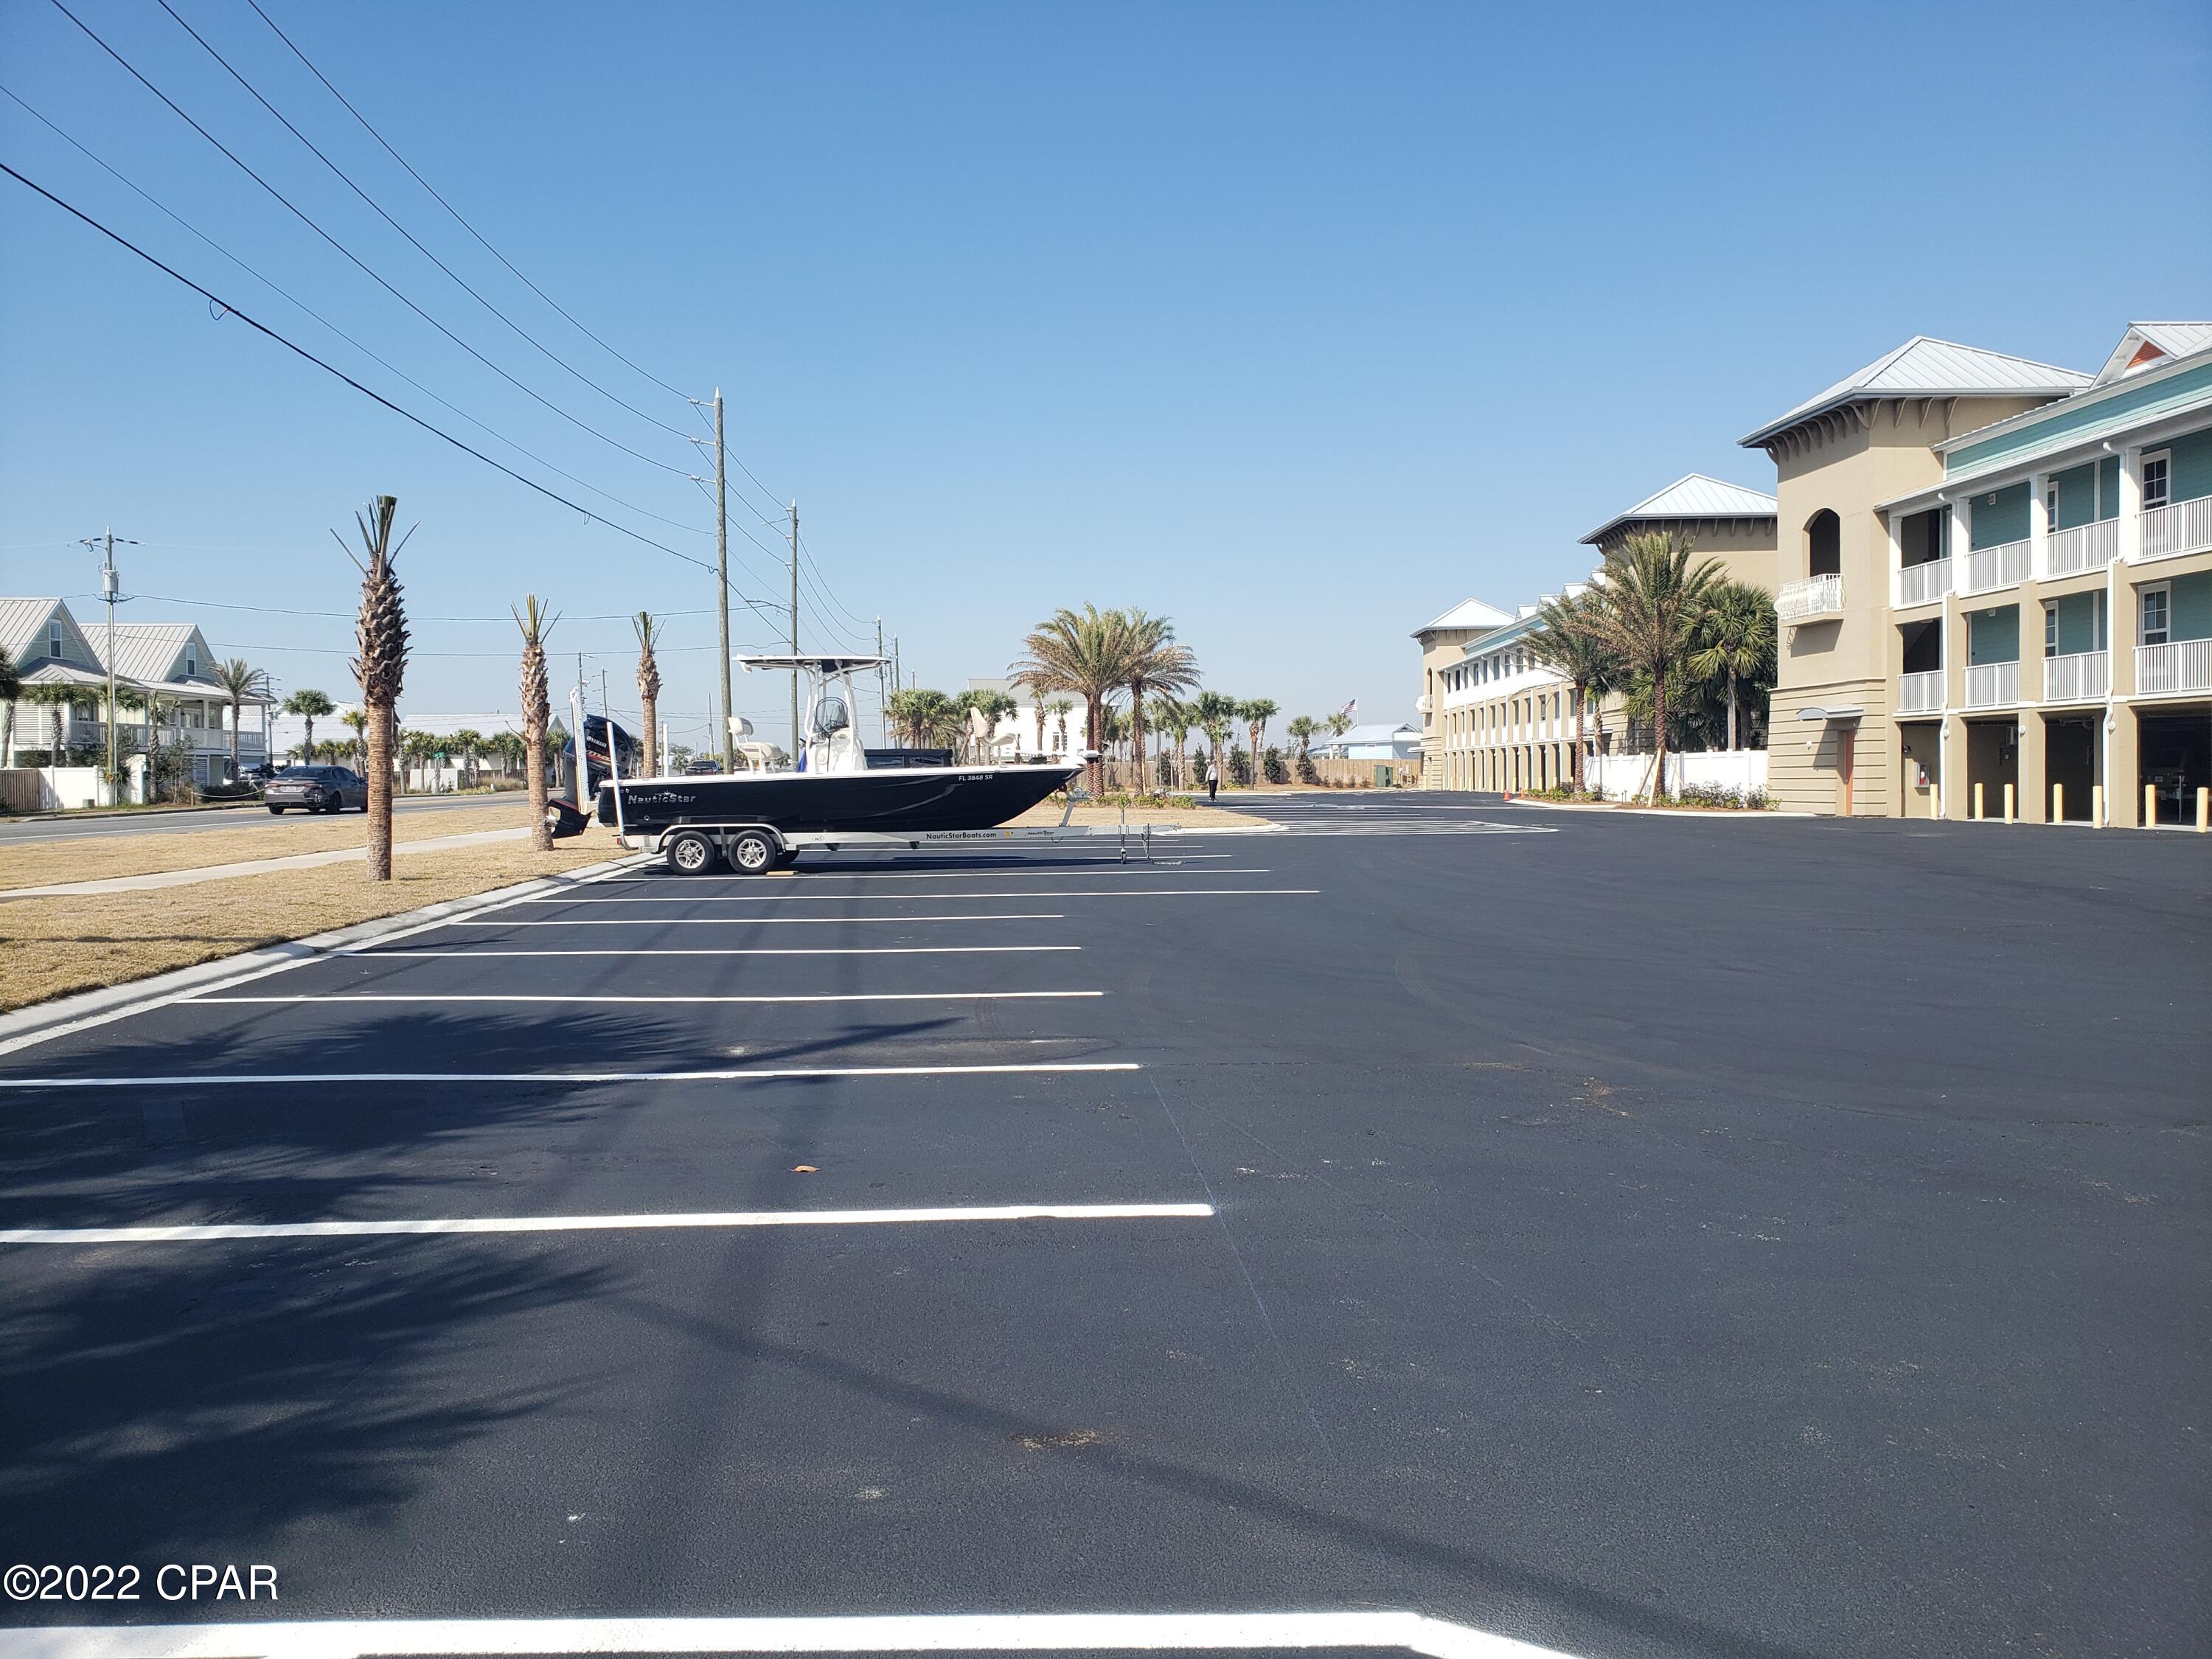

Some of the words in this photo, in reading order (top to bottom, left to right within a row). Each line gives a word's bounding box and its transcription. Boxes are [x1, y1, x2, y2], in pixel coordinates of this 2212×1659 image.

[591, 738, 607, 748] YAMAHA
[627, 794, 696, 804] NauticStar
[926, 832, 997, 840] NauticStarBoats.com
